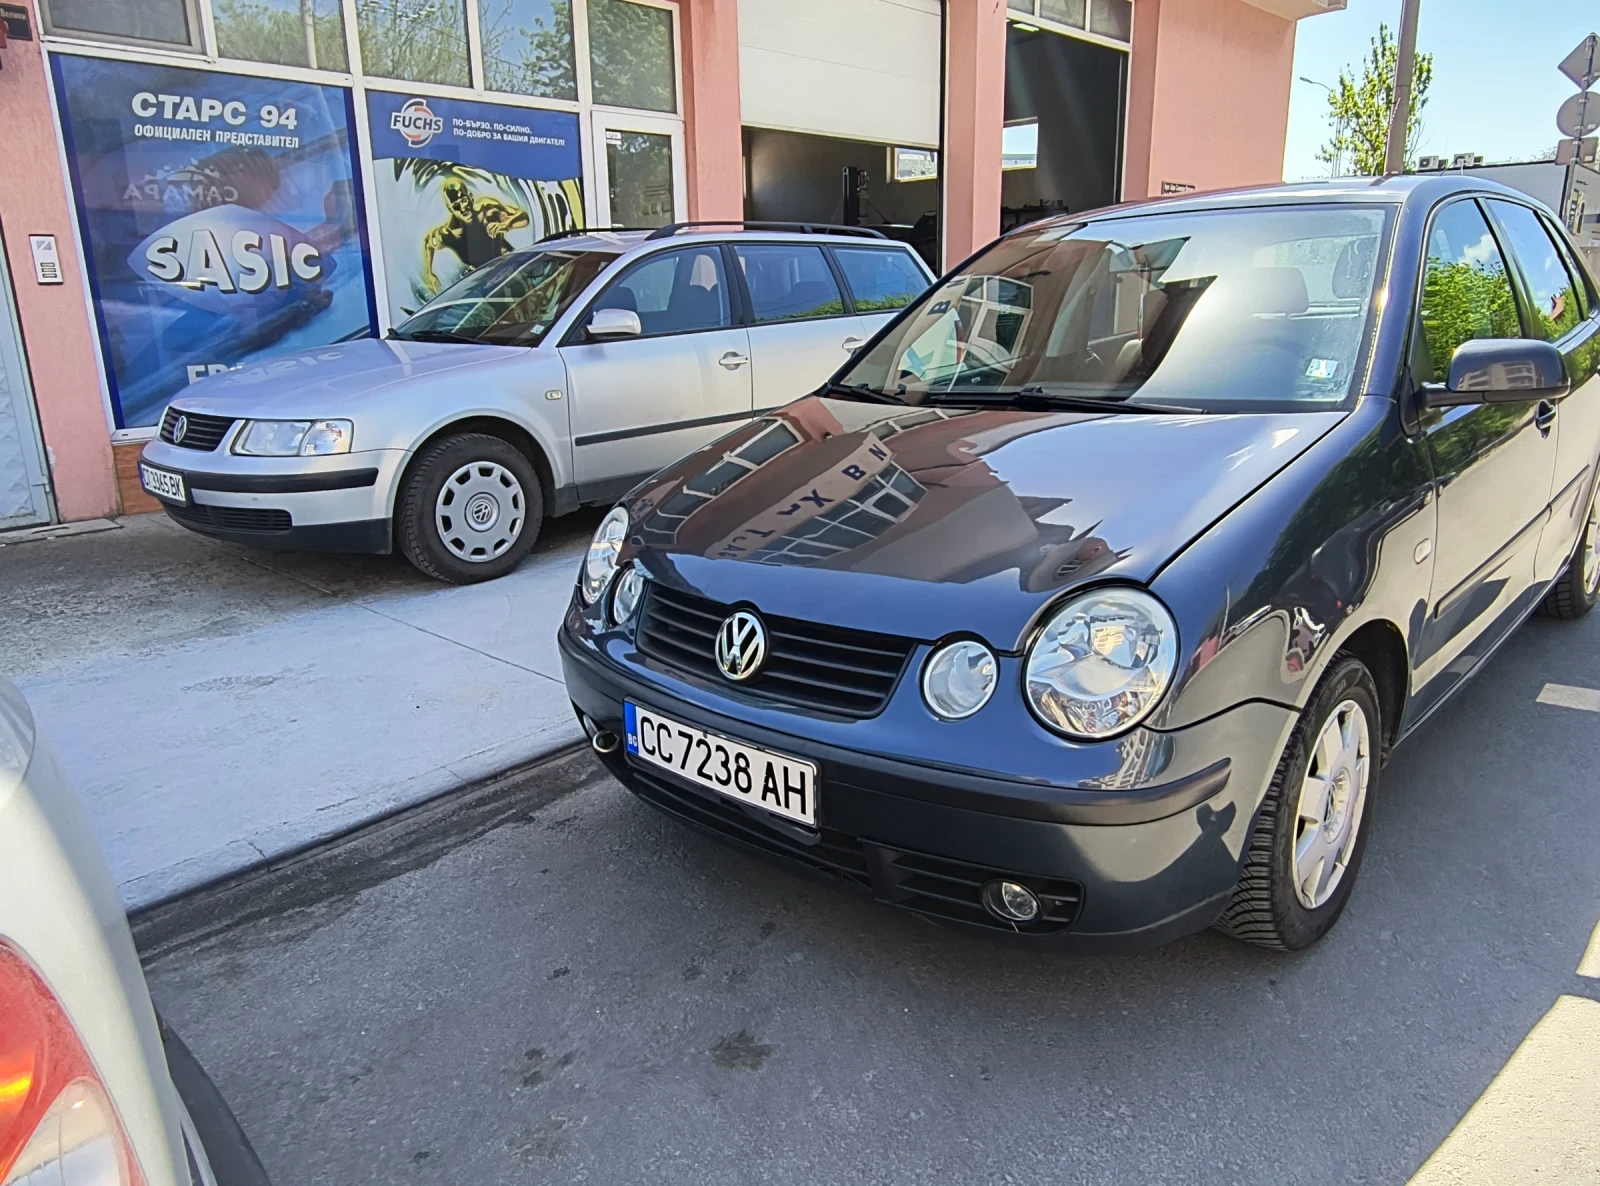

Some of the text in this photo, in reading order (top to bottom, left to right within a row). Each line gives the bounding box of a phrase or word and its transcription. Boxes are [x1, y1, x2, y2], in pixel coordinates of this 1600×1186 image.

[131, 92, 298, 130] СТАРС 94
[393, 115, 442, 132] FUCHS
[452, 118, 492, 130] ПО-БЪРЗО.
[134, 123, 299, 149] ОФИЦИАЛЕН ПРЕДСТАВИТЕЛ
[453, 128, 492, 139] ПО-ДОБРО
[492, 132, 502, 140] ЗА
[503, 133, 529, 143] ВАШИЯ
[145, 229, 325, 294] SASIC
[627, 733, 638, 747] BG
[640, 716, 807, 815] CC 7238 AH
